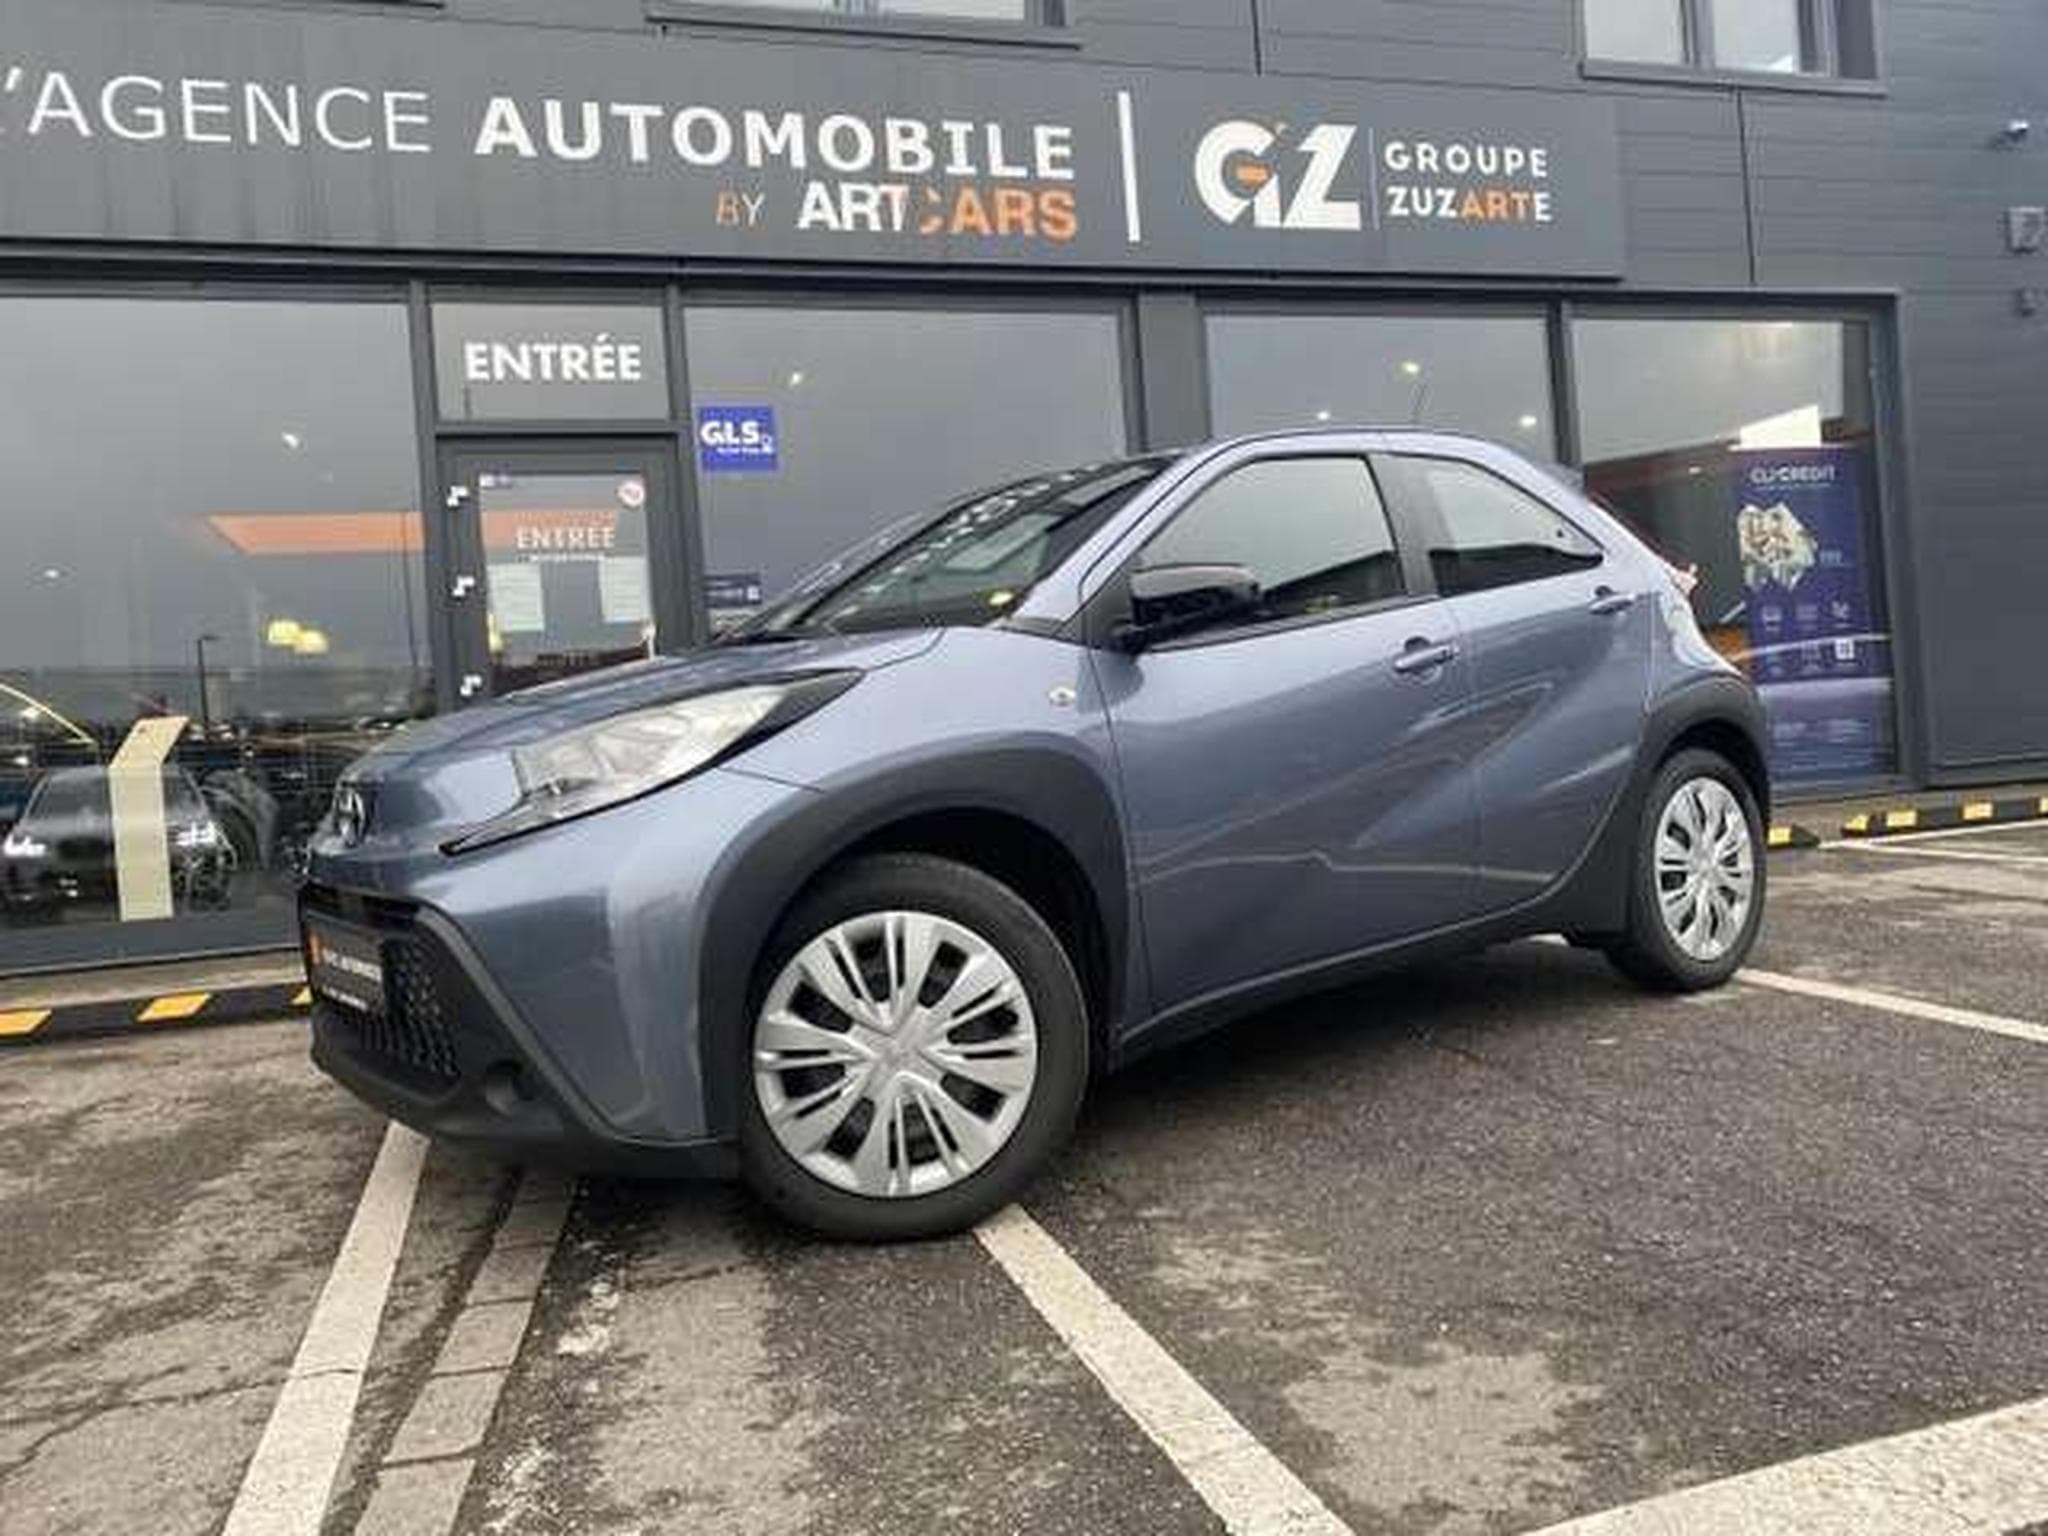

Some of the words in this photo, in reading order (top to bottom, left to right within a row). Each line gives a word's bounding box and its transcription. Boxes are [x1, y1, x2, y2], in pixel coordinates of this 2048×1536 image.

[0, 66, 432, 153] 'AGENCE
[474, 96, 1076, 181] AUTOMOBILE
[1384, 141, 1549, 178] GROUPE
[715, 191, 765, 226] BY
[1386, 186, 1552, 223] ZUZARTE
[464, 333, 643, 382] ENTRÉE
[701, 421, 760, 446] GLS
